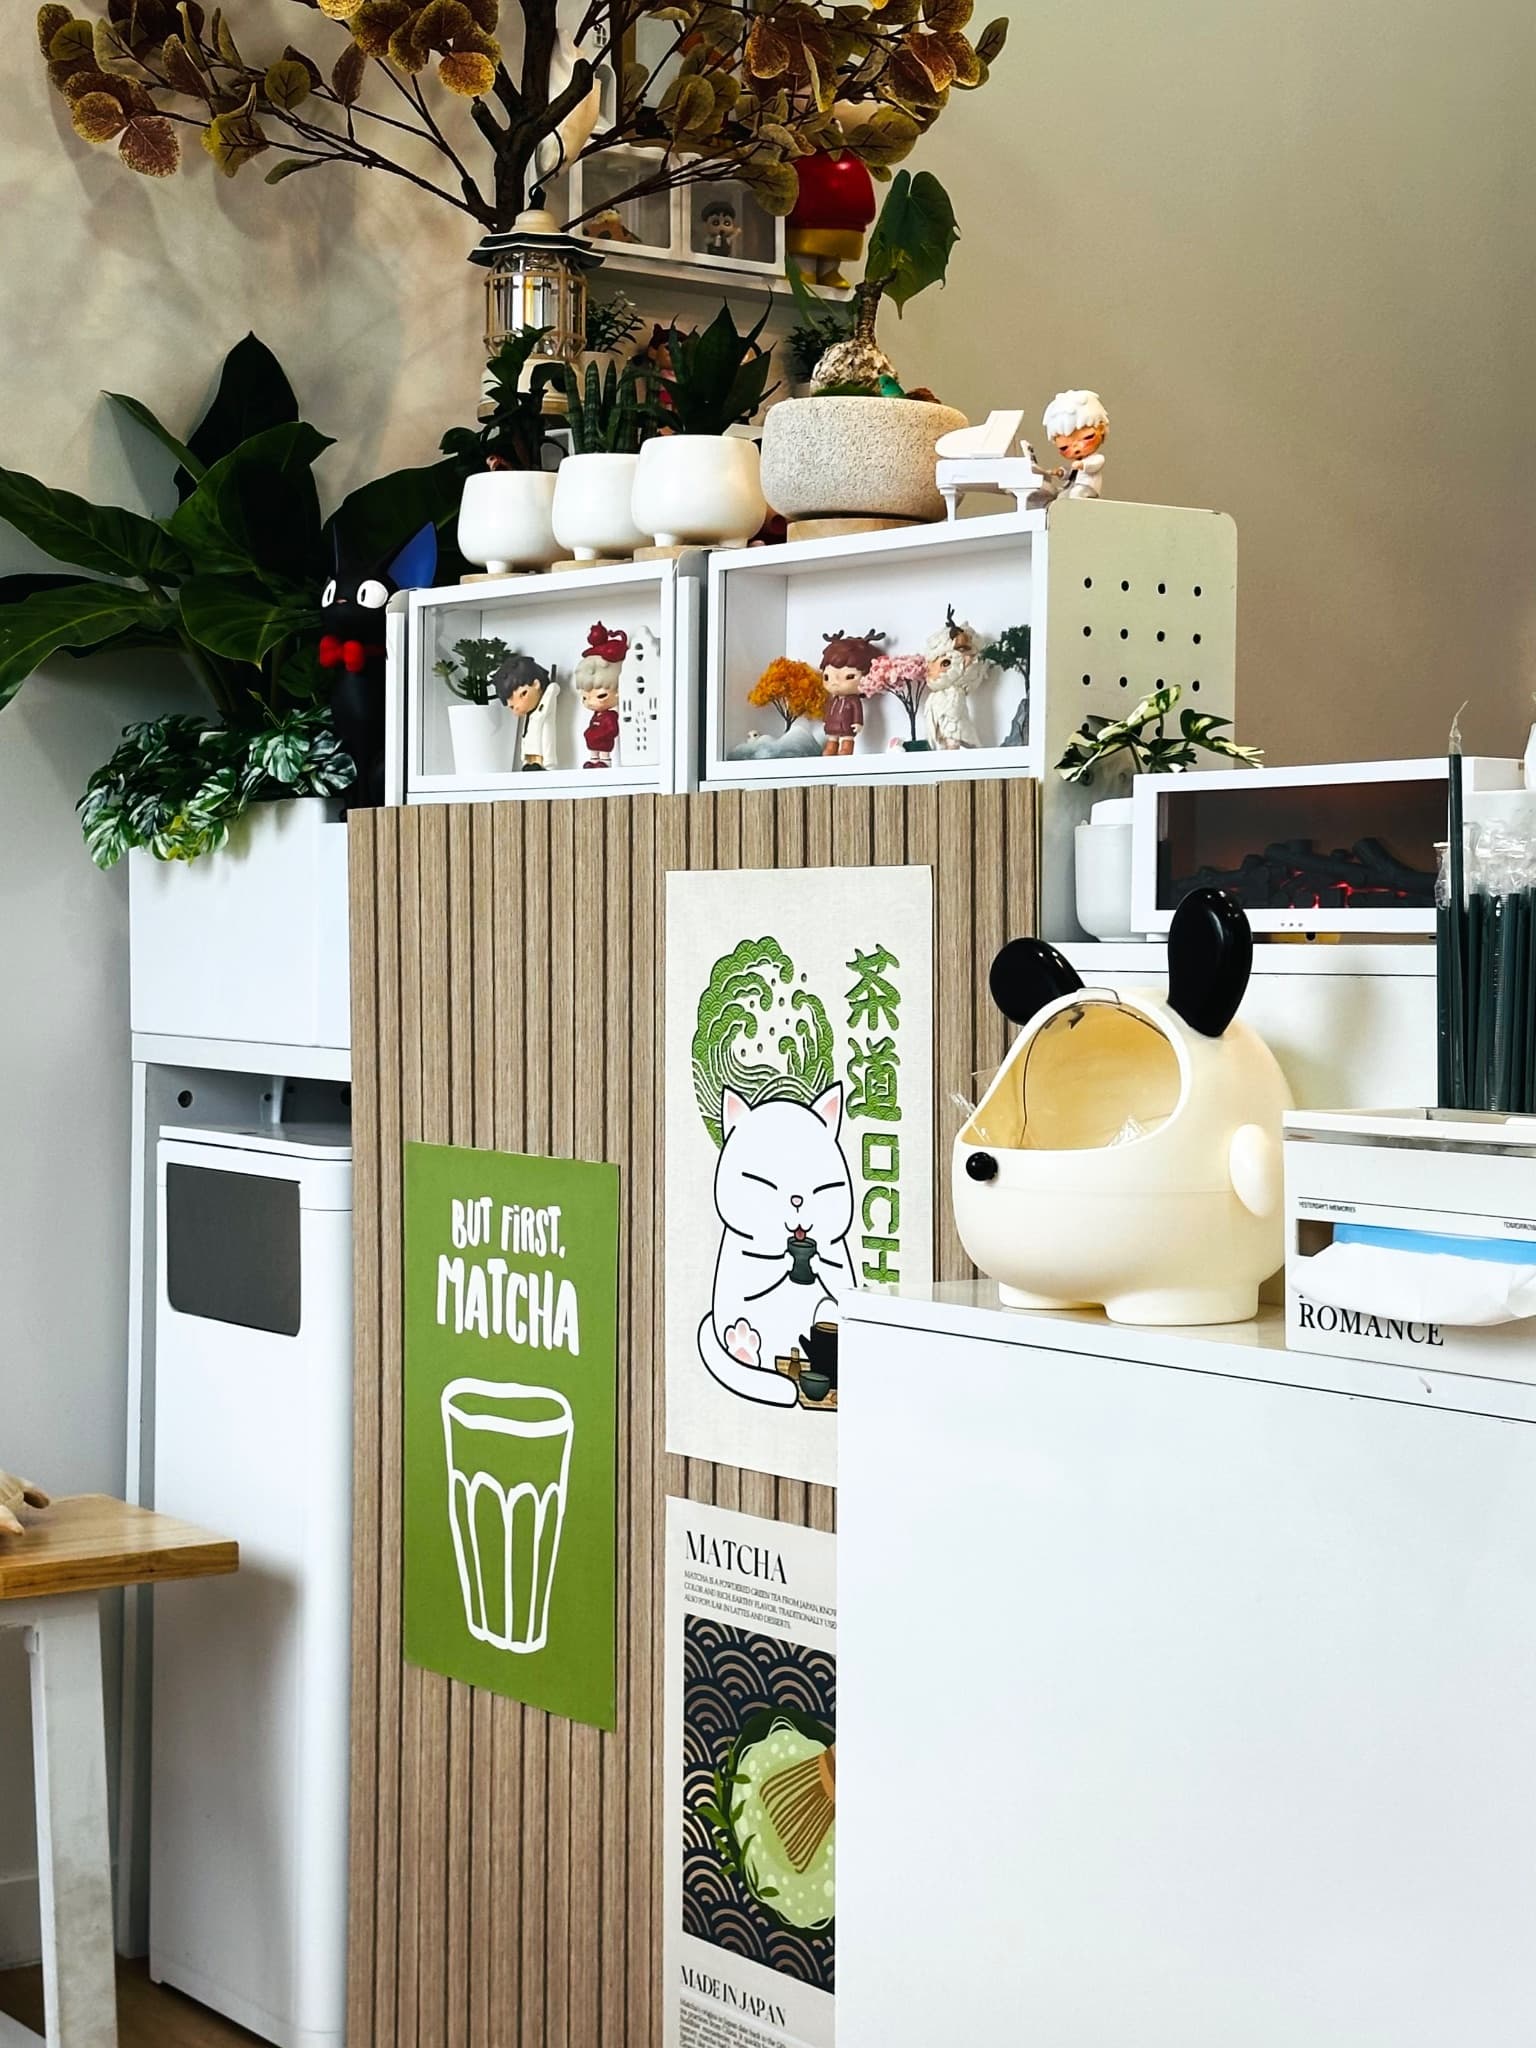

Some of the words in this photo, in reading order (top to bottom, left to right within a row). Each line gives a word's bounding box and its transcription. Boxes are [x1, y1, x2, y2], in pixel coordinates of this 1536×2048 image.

[844, 943, 902, 1121] 茶道
[451, 1196, 493, 1249] BUT
[436, 1254, 580, 1357] MATCHA
[1298, 1302, 1444, 1346] ROMANCE
[685, 1530, 788, 1585] MATCHA
[684, 1569, 706, 1582] MATCHA
[750, 1587, 770, 1600] GREEN
[770, 1593, 780, 1602] TEA
[782, 1596, 799, 1608] FROM
[680, 1965, 720, 1999] MADE
[723, 1983, 737, 2006] IN
[739, 1991, 787, 2027] JAPAN
